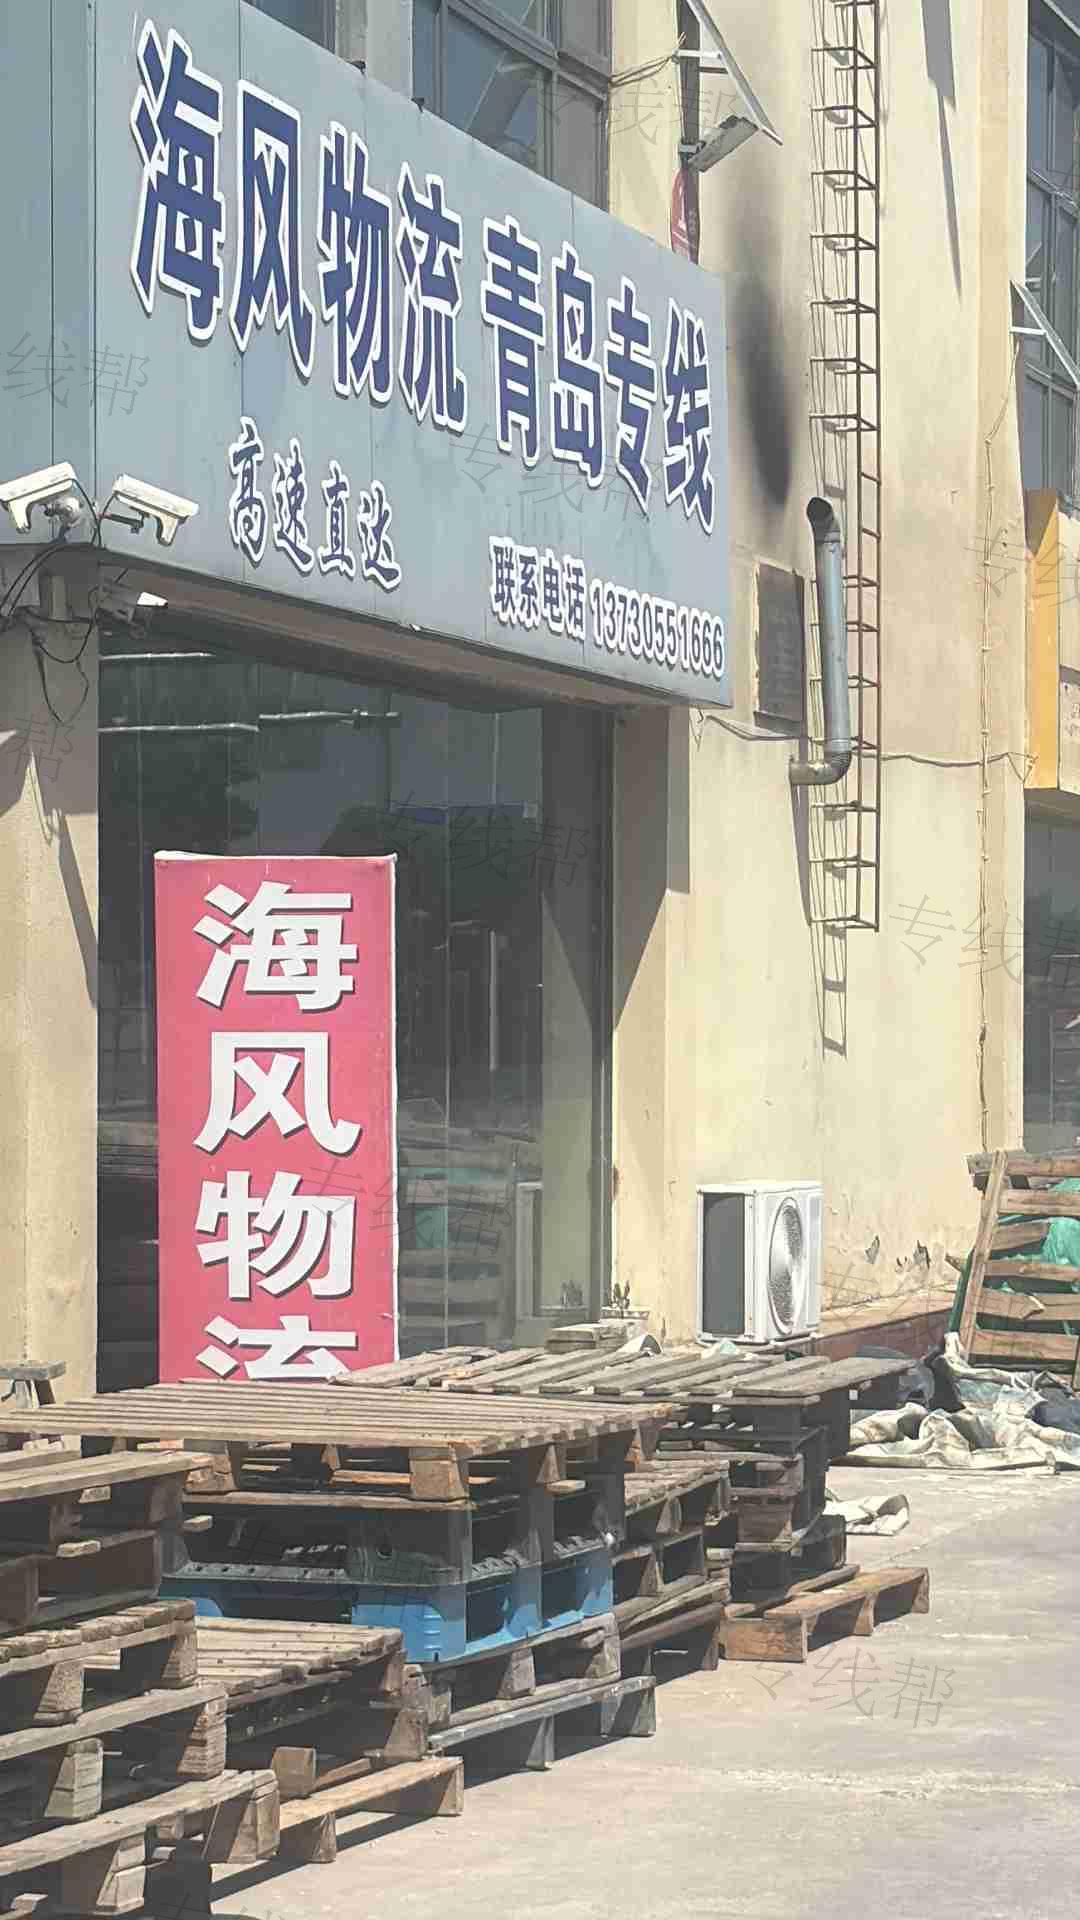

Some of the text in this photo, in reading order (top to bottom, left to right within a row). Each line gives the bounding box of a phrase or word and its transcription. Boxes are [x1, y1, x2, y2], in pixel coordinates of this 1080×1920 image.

[130, 19, 715, 535] 海风物流 青岛专线
[228, 416, 402, 589] 高速直达
[488, 535, 726, 678] 联系电话 13730551666
